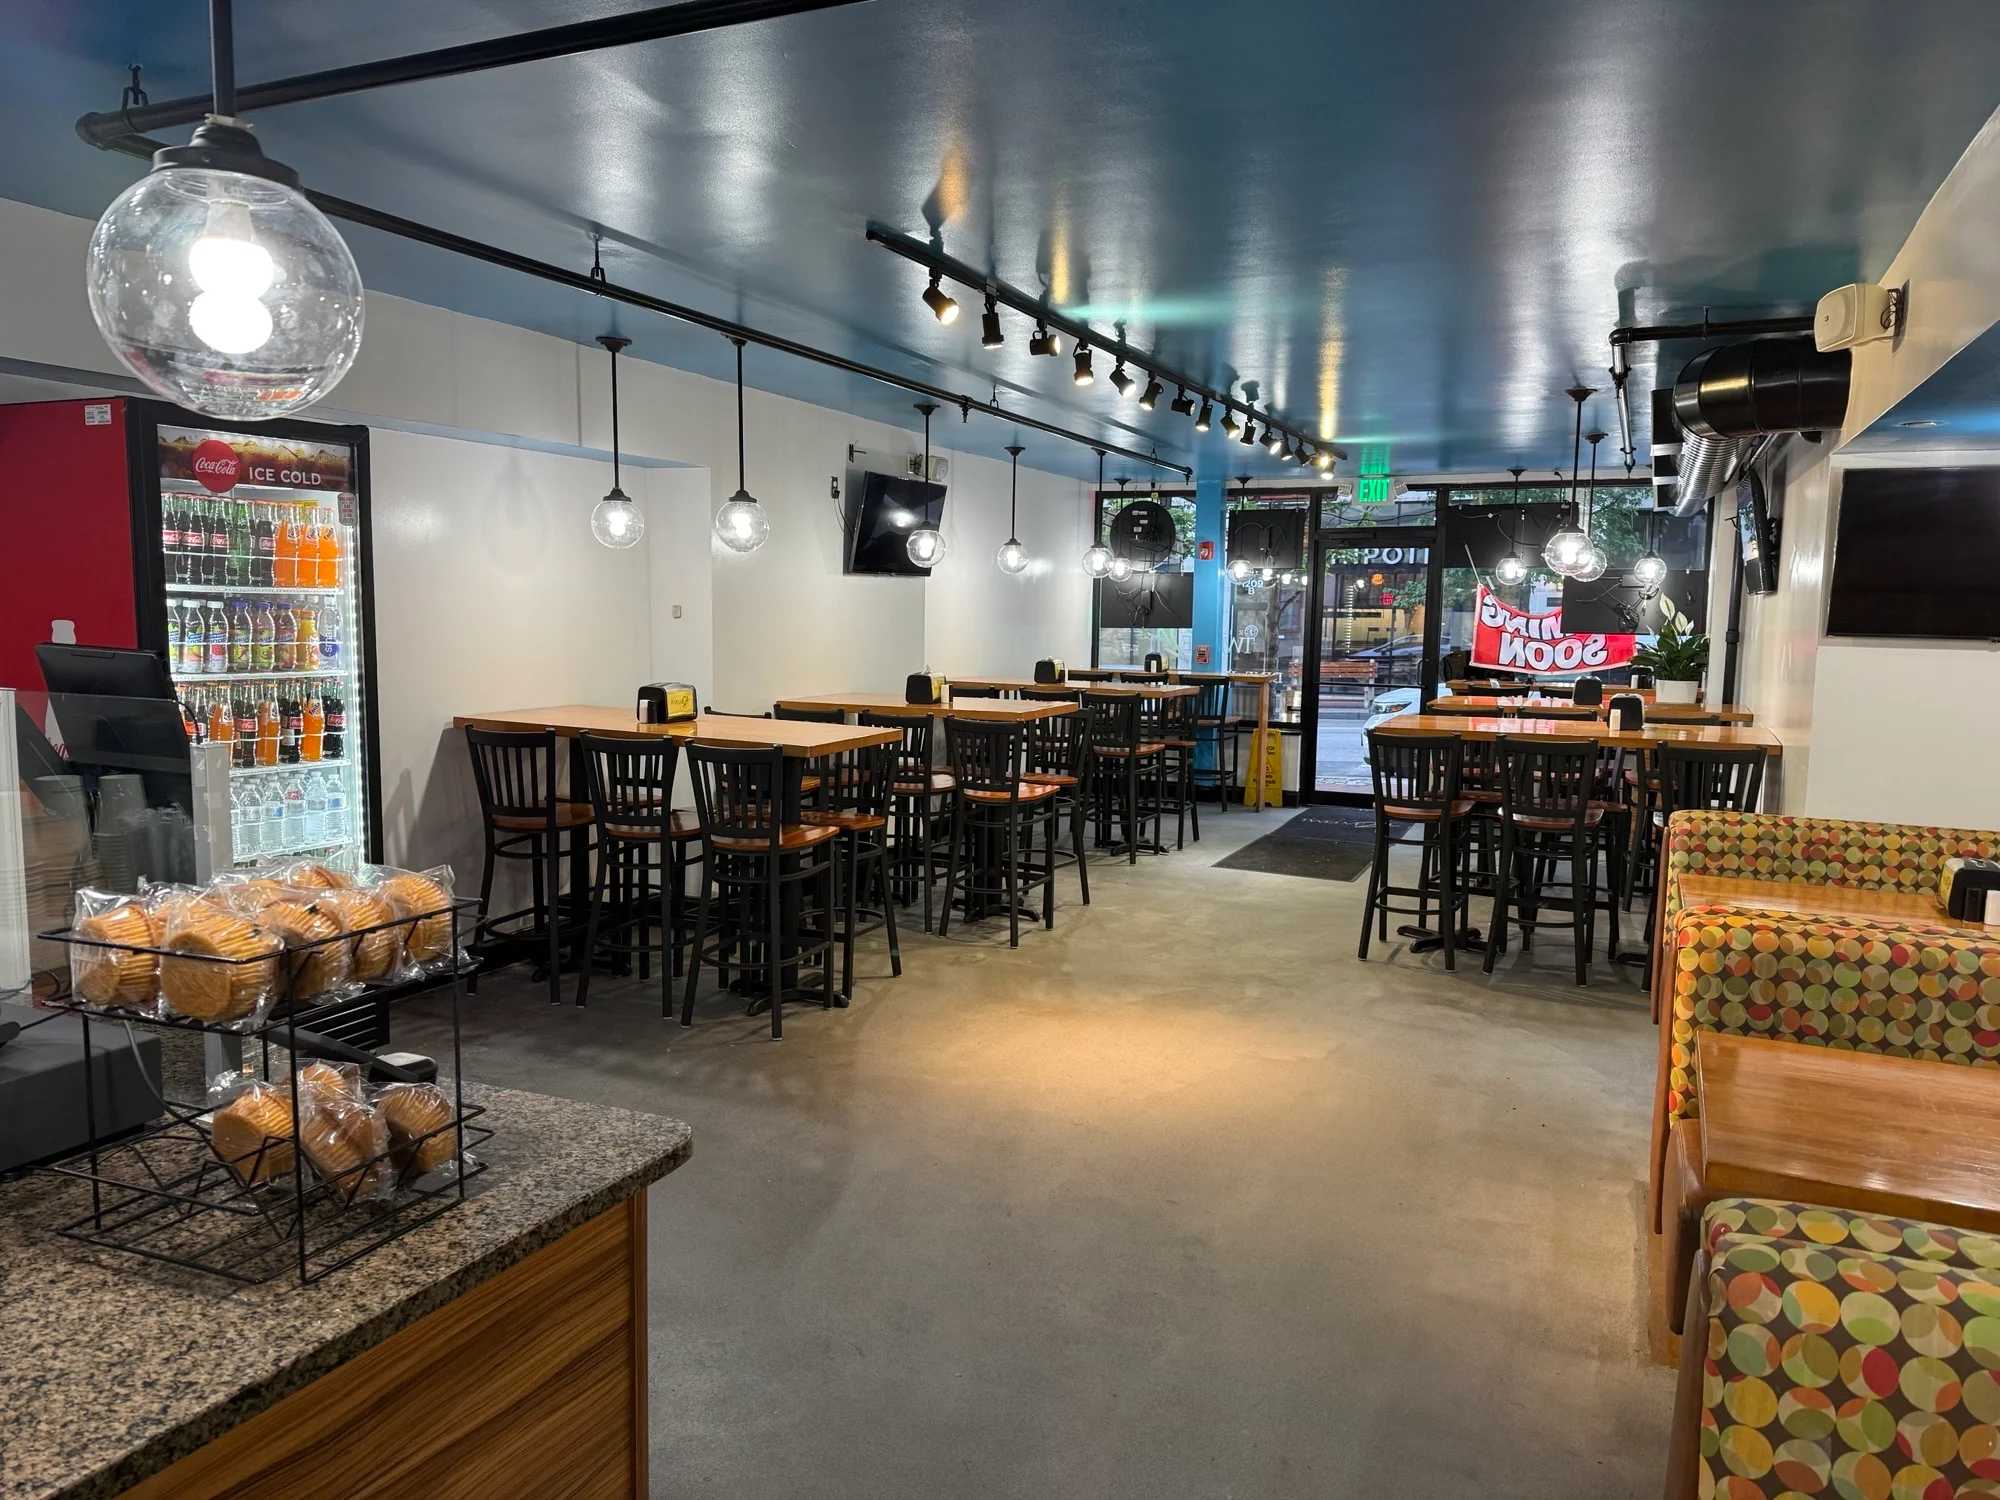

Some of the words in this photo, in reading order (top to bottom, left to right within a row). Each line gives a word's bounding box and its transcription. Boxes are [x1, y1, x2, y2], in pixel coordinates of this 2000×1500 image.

[195, 457, 238, 476] Coca-Cola
[248, 466, 276, 482] ICE
[280, 469, 321, 485] COLD
[1359, 479, 1390, 502] EXIT
